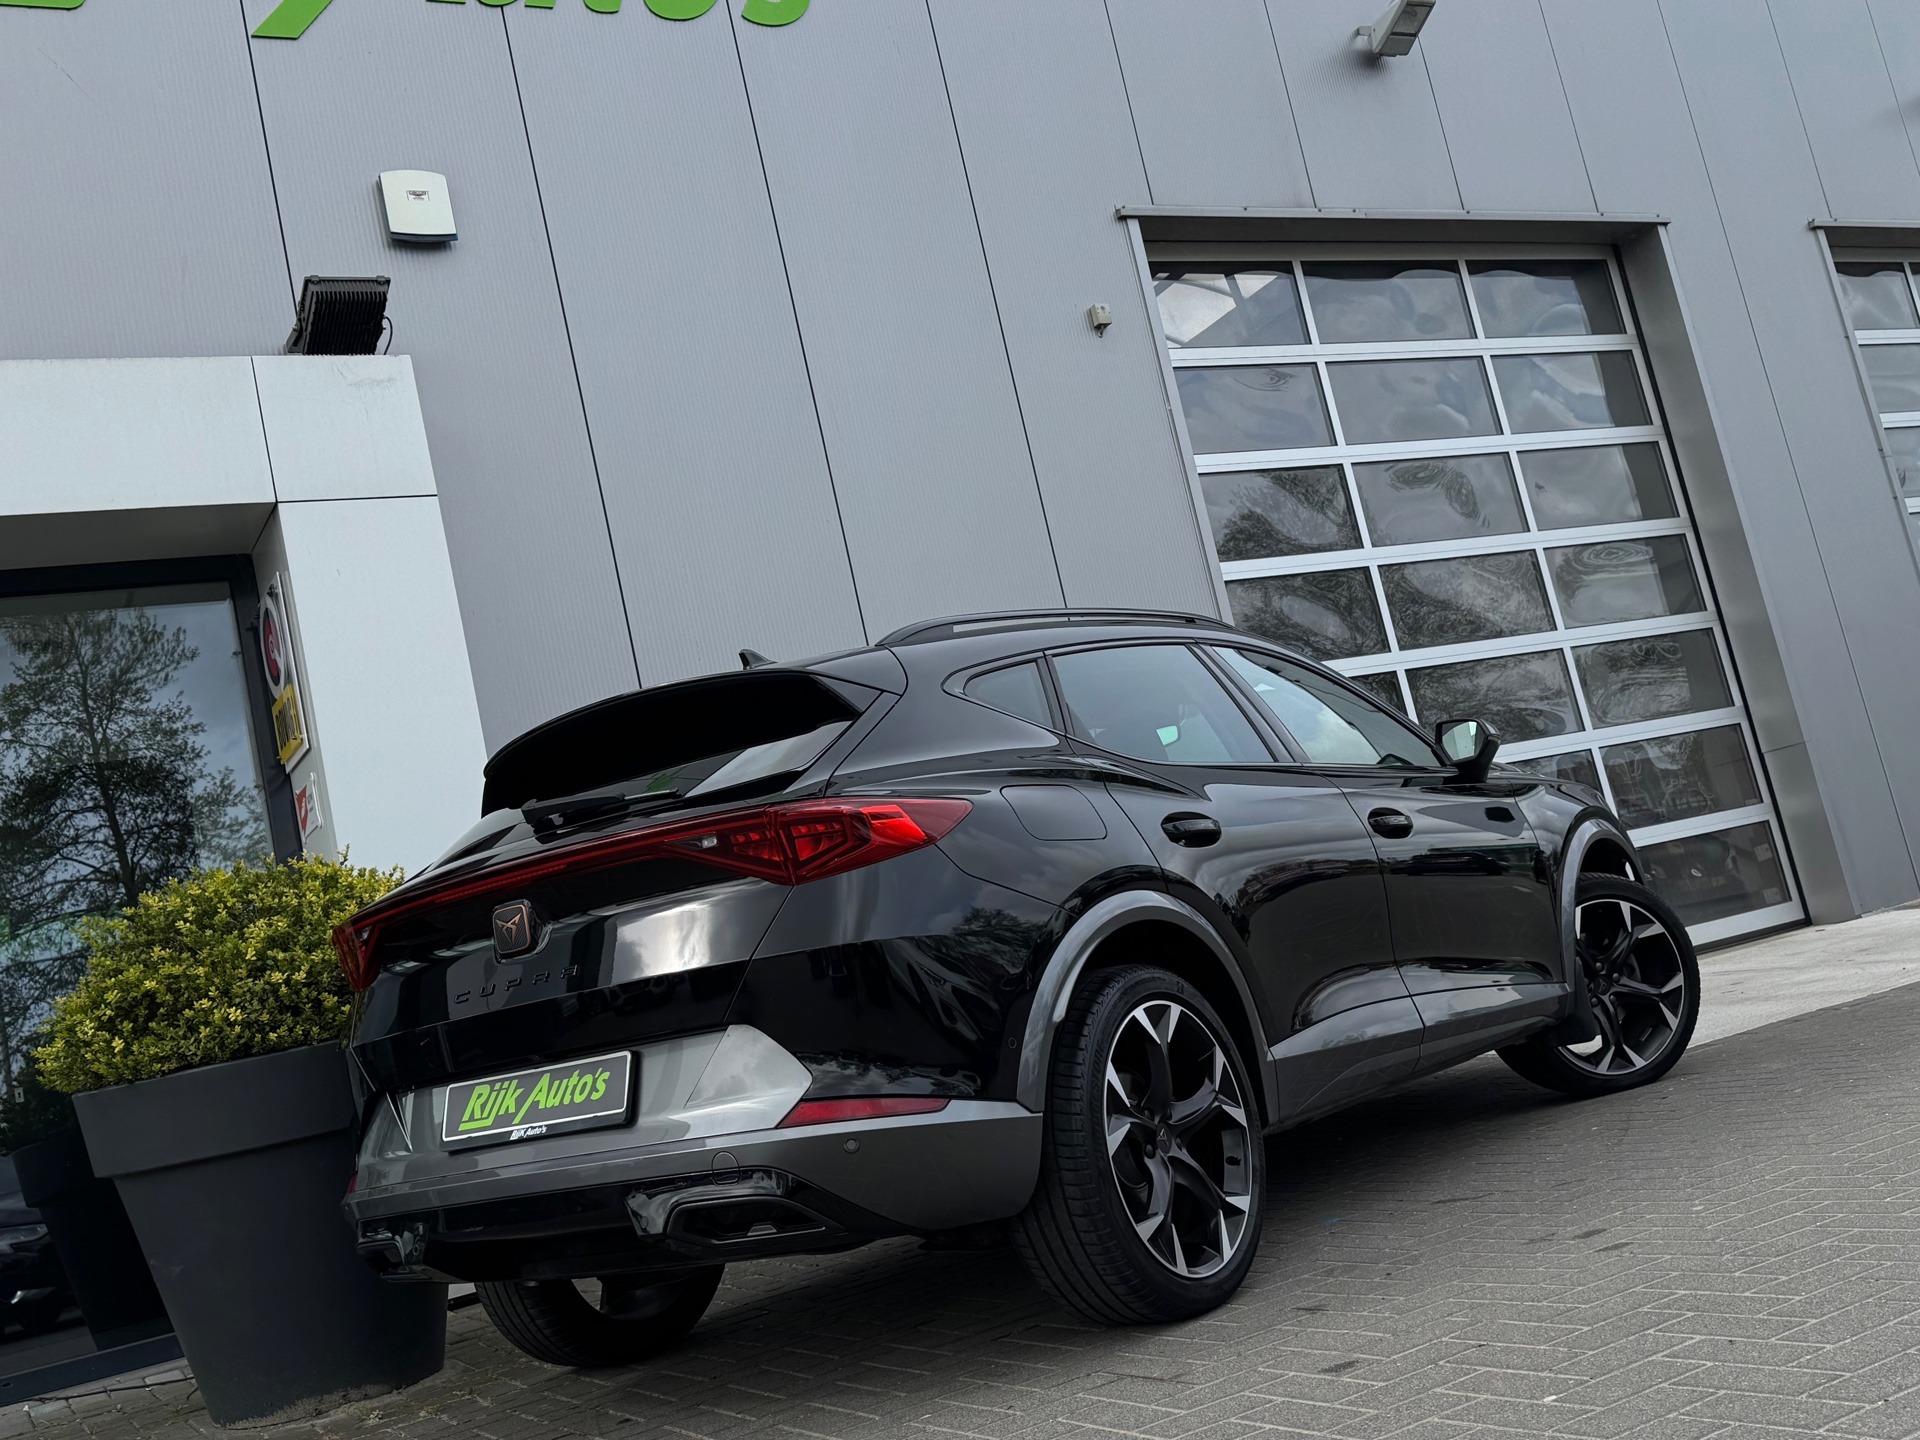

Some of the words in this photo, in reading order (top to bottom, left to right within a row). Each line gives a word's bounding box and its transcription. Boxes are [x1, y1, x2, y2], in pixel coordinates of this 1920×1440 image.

[454, 964, 578, 1004] CUPRA
[458, 1080, 524, 1131] Rijk
[512, 1067, 611, 1124] Auto's
